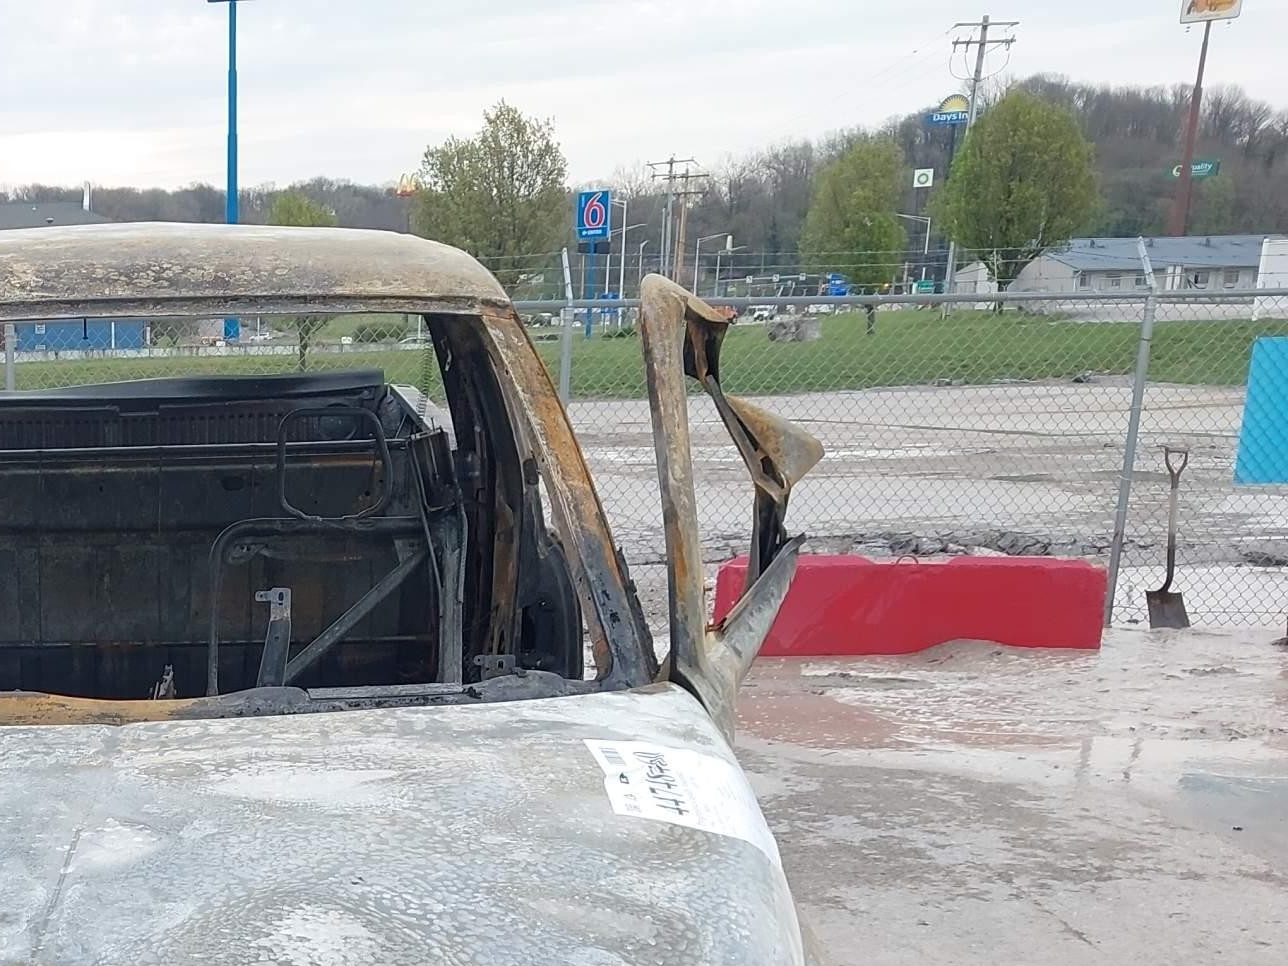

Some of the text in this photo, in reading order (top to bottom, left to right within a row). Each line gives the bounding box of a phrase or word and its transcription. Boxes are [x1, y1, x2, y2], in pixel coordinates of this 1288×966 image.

[932, 112, 968, 122] Days In
[584, 192, 606, 228] 6
